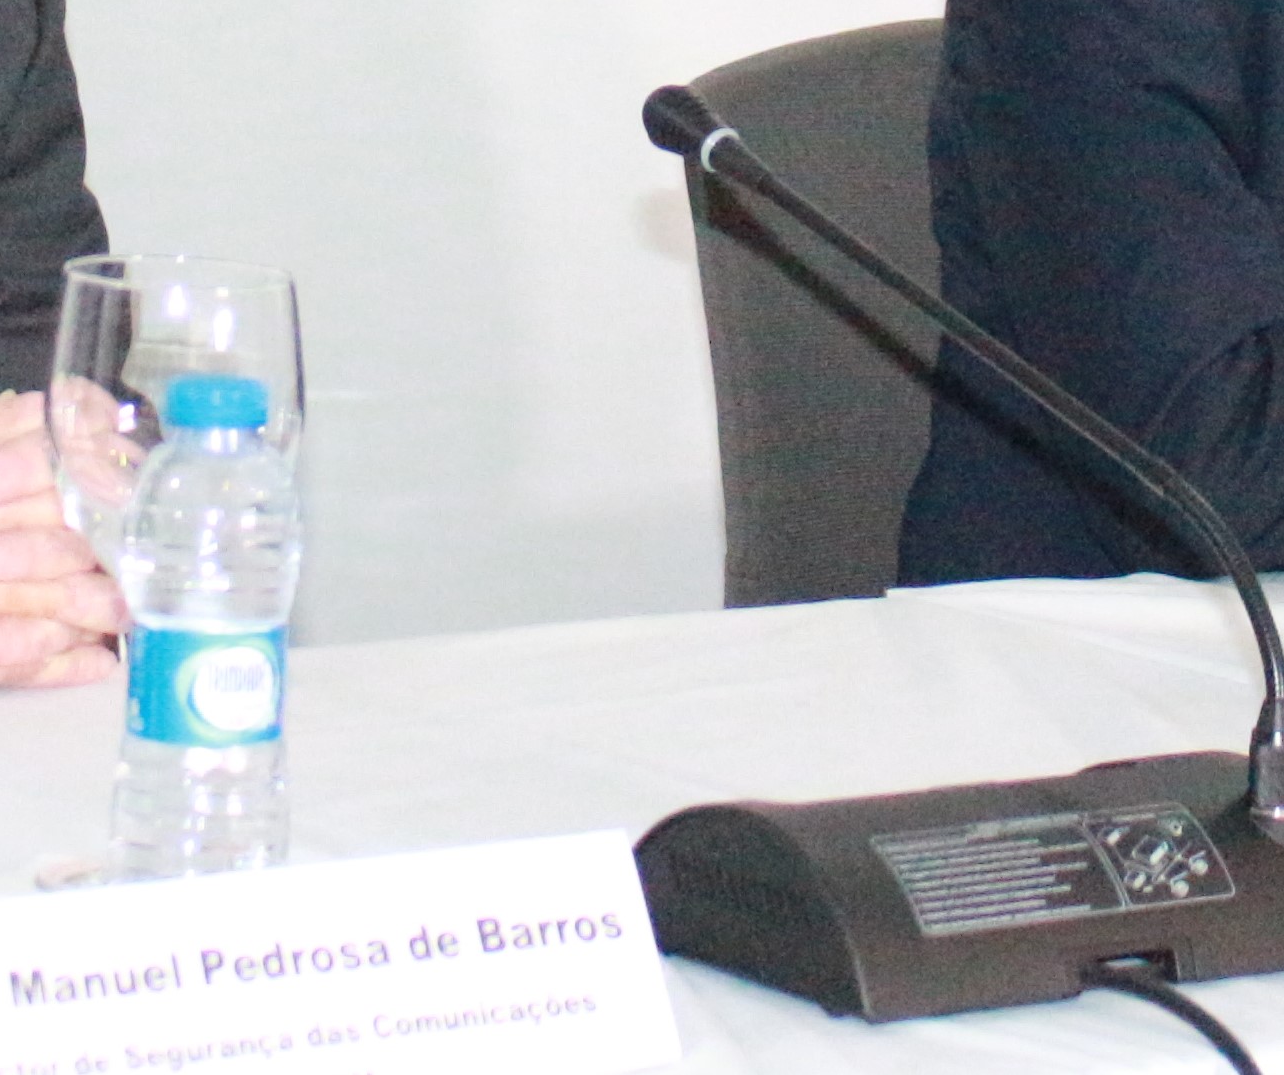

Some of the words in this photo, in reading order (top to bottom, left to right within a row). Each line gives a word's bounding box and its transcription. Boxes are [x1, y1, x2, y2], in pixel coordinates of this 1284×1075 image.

[9, 953, 181, 1007] Manuel
[199, 940, 390, 985] Pedrosa
[408, 925, 460, 962] de
[475, 912, 623, 954] Barros
[123, 1034, 294, 1072] Segurança
[306, 1023, 361, 1048] das
[372, 993, 597, 1039] Comunicações
